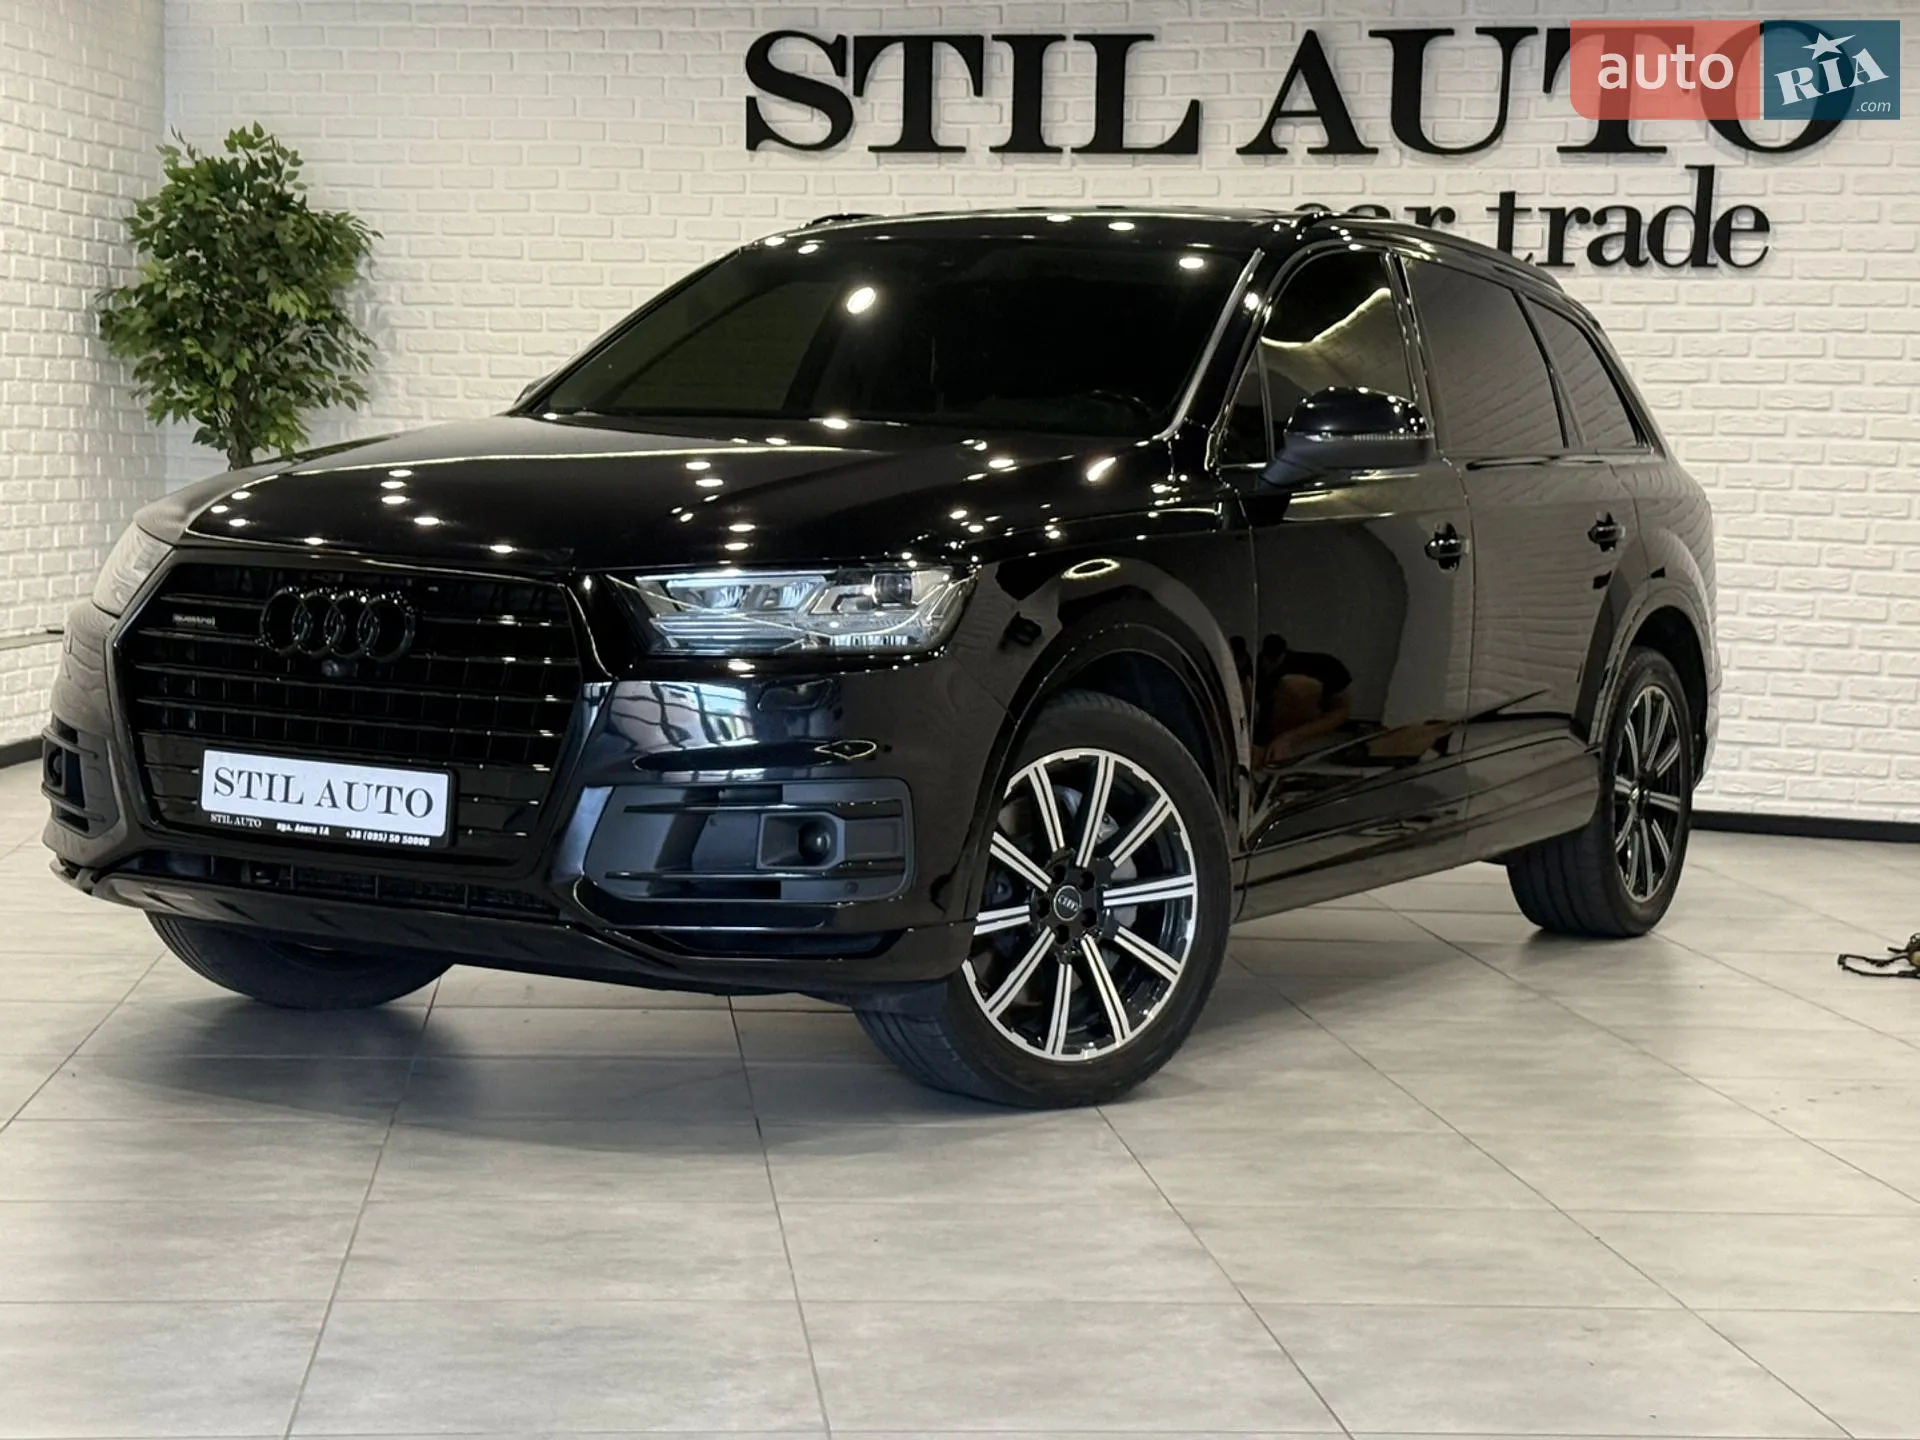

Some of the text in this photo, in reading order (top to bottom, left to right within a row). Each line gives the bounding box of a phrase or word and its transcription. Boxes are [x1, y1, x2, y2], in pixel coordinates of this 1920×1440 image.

[745, 21, 1855, 156] STIL AUTO
[1486, 164, 1771, 269] trade
[210, 813, 262, 829] STIL AUTO
[213, 766, 434, 819] STIL AUTO
